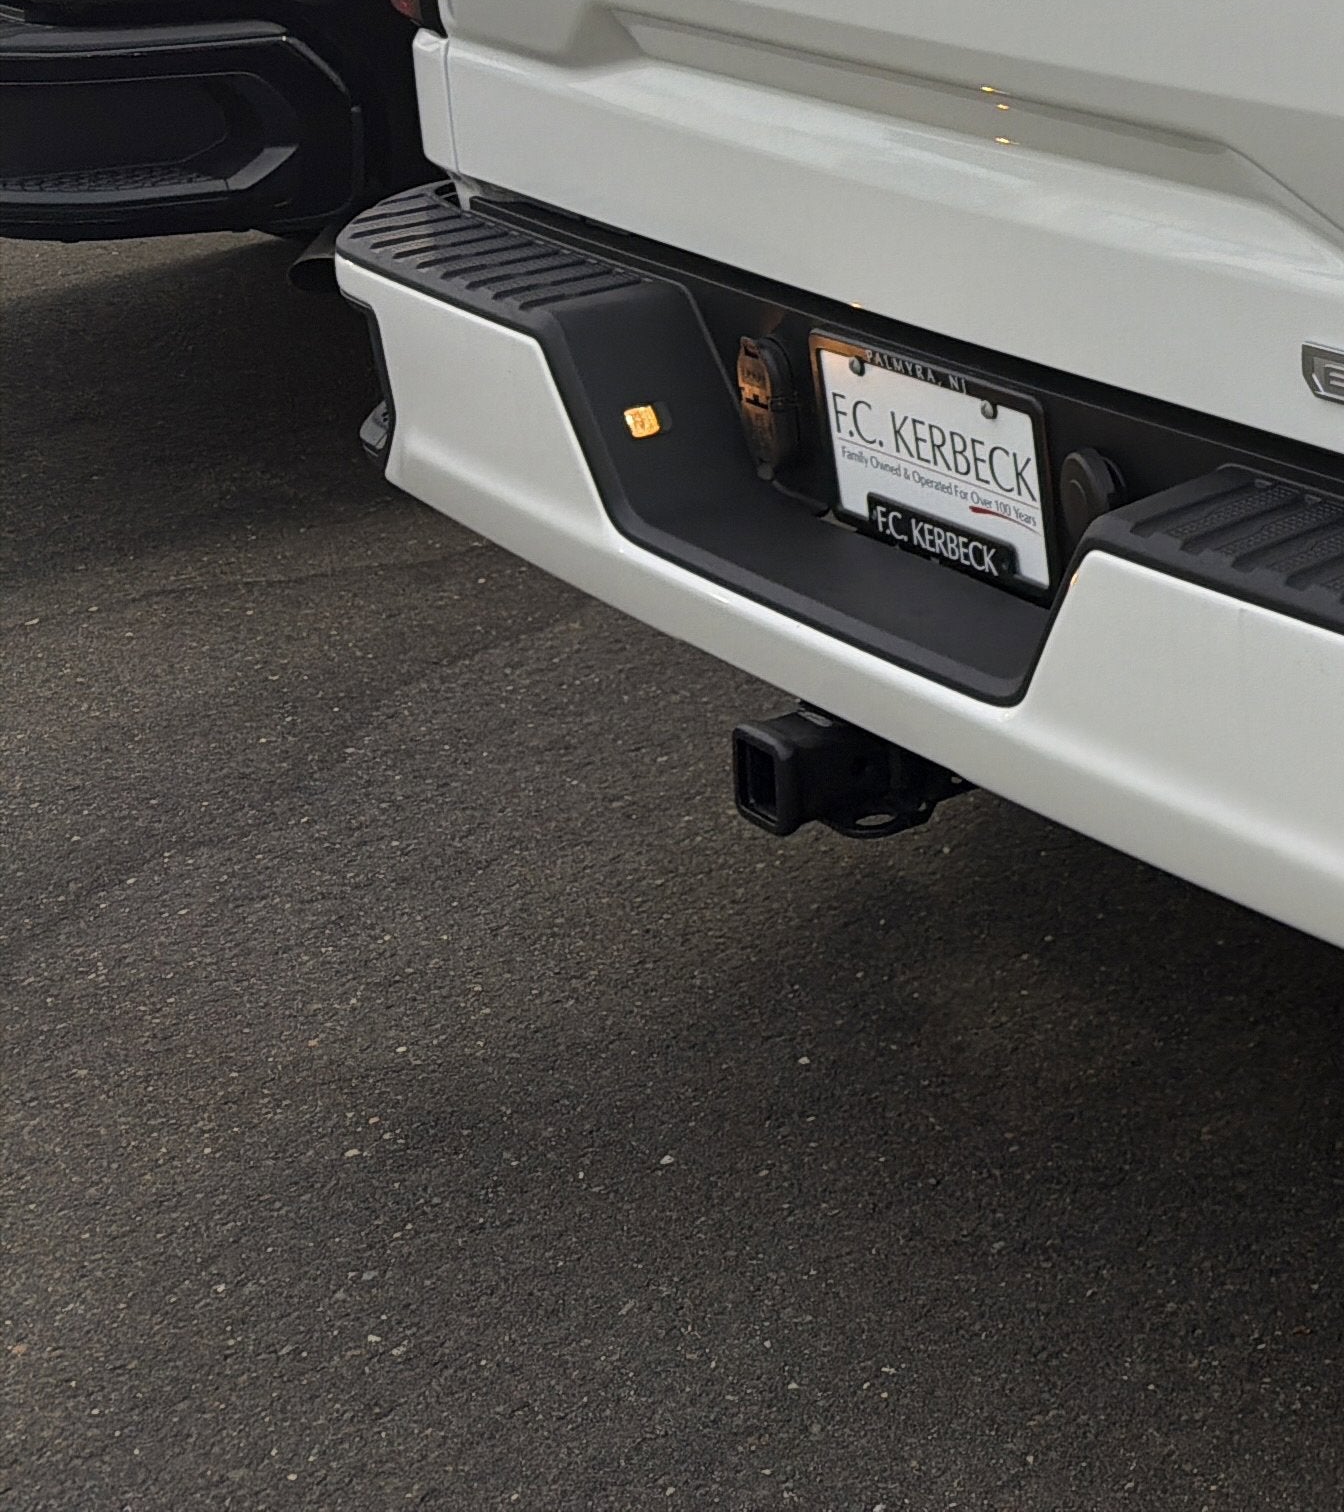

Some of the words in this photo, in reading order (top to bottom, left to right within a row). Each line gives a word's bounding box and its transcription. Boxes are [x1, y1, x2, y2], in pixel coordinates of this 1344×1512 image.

[948, 373, 967, 395] NJ
[831, 391, 885, 448] F.C.
[890, 410, 1038, 503] KERBECK
[841, 446, 868, 468] Family
[870, 455, 902, 477] Owned
[903, 468, 911, 481] &
[912, 470, 953, 496] Operated
[954, 485, 969, 500] For
[970, 491, 993, 509] Over
[995, 500, 1012, 517] 100
[1013, 506, 1037, 527] Years
[911, 517, 1000, 577] KERBECK
